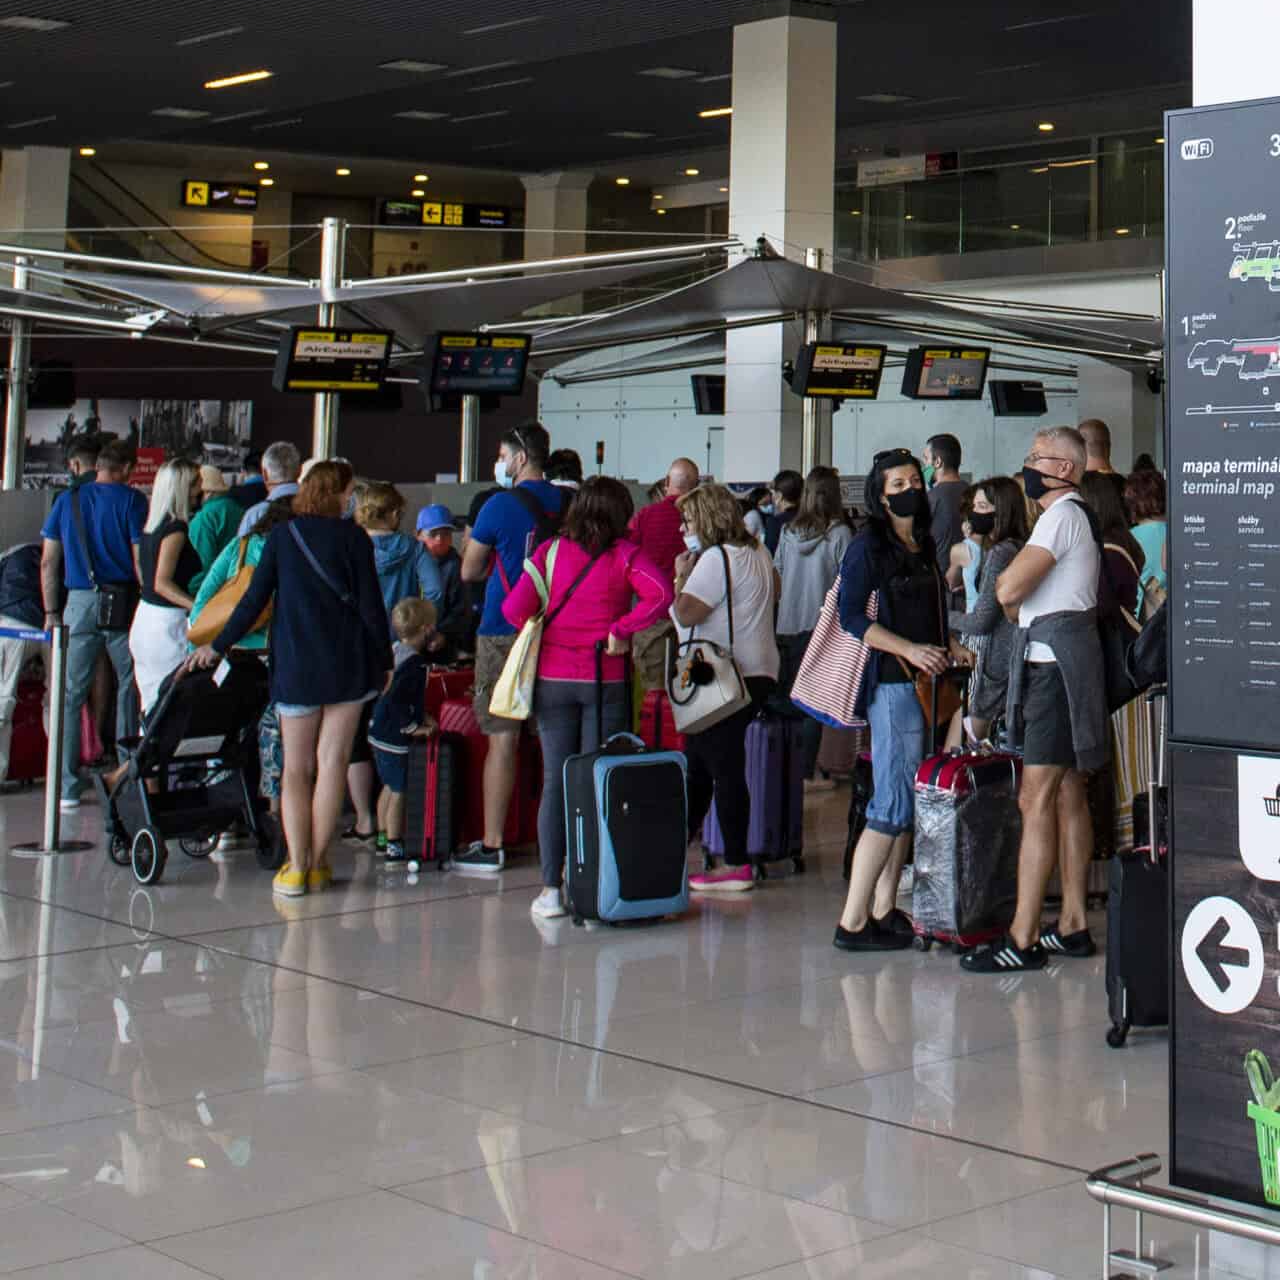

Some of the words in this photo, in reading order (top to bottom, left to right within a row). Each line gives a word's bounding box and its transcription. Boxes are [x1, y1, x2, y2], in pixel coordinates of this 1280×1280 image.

[1182, 459, 1221, 477] mapa
[1182, 478, 1240, 495] terminal
[1243, 482, 1275, 499] map
